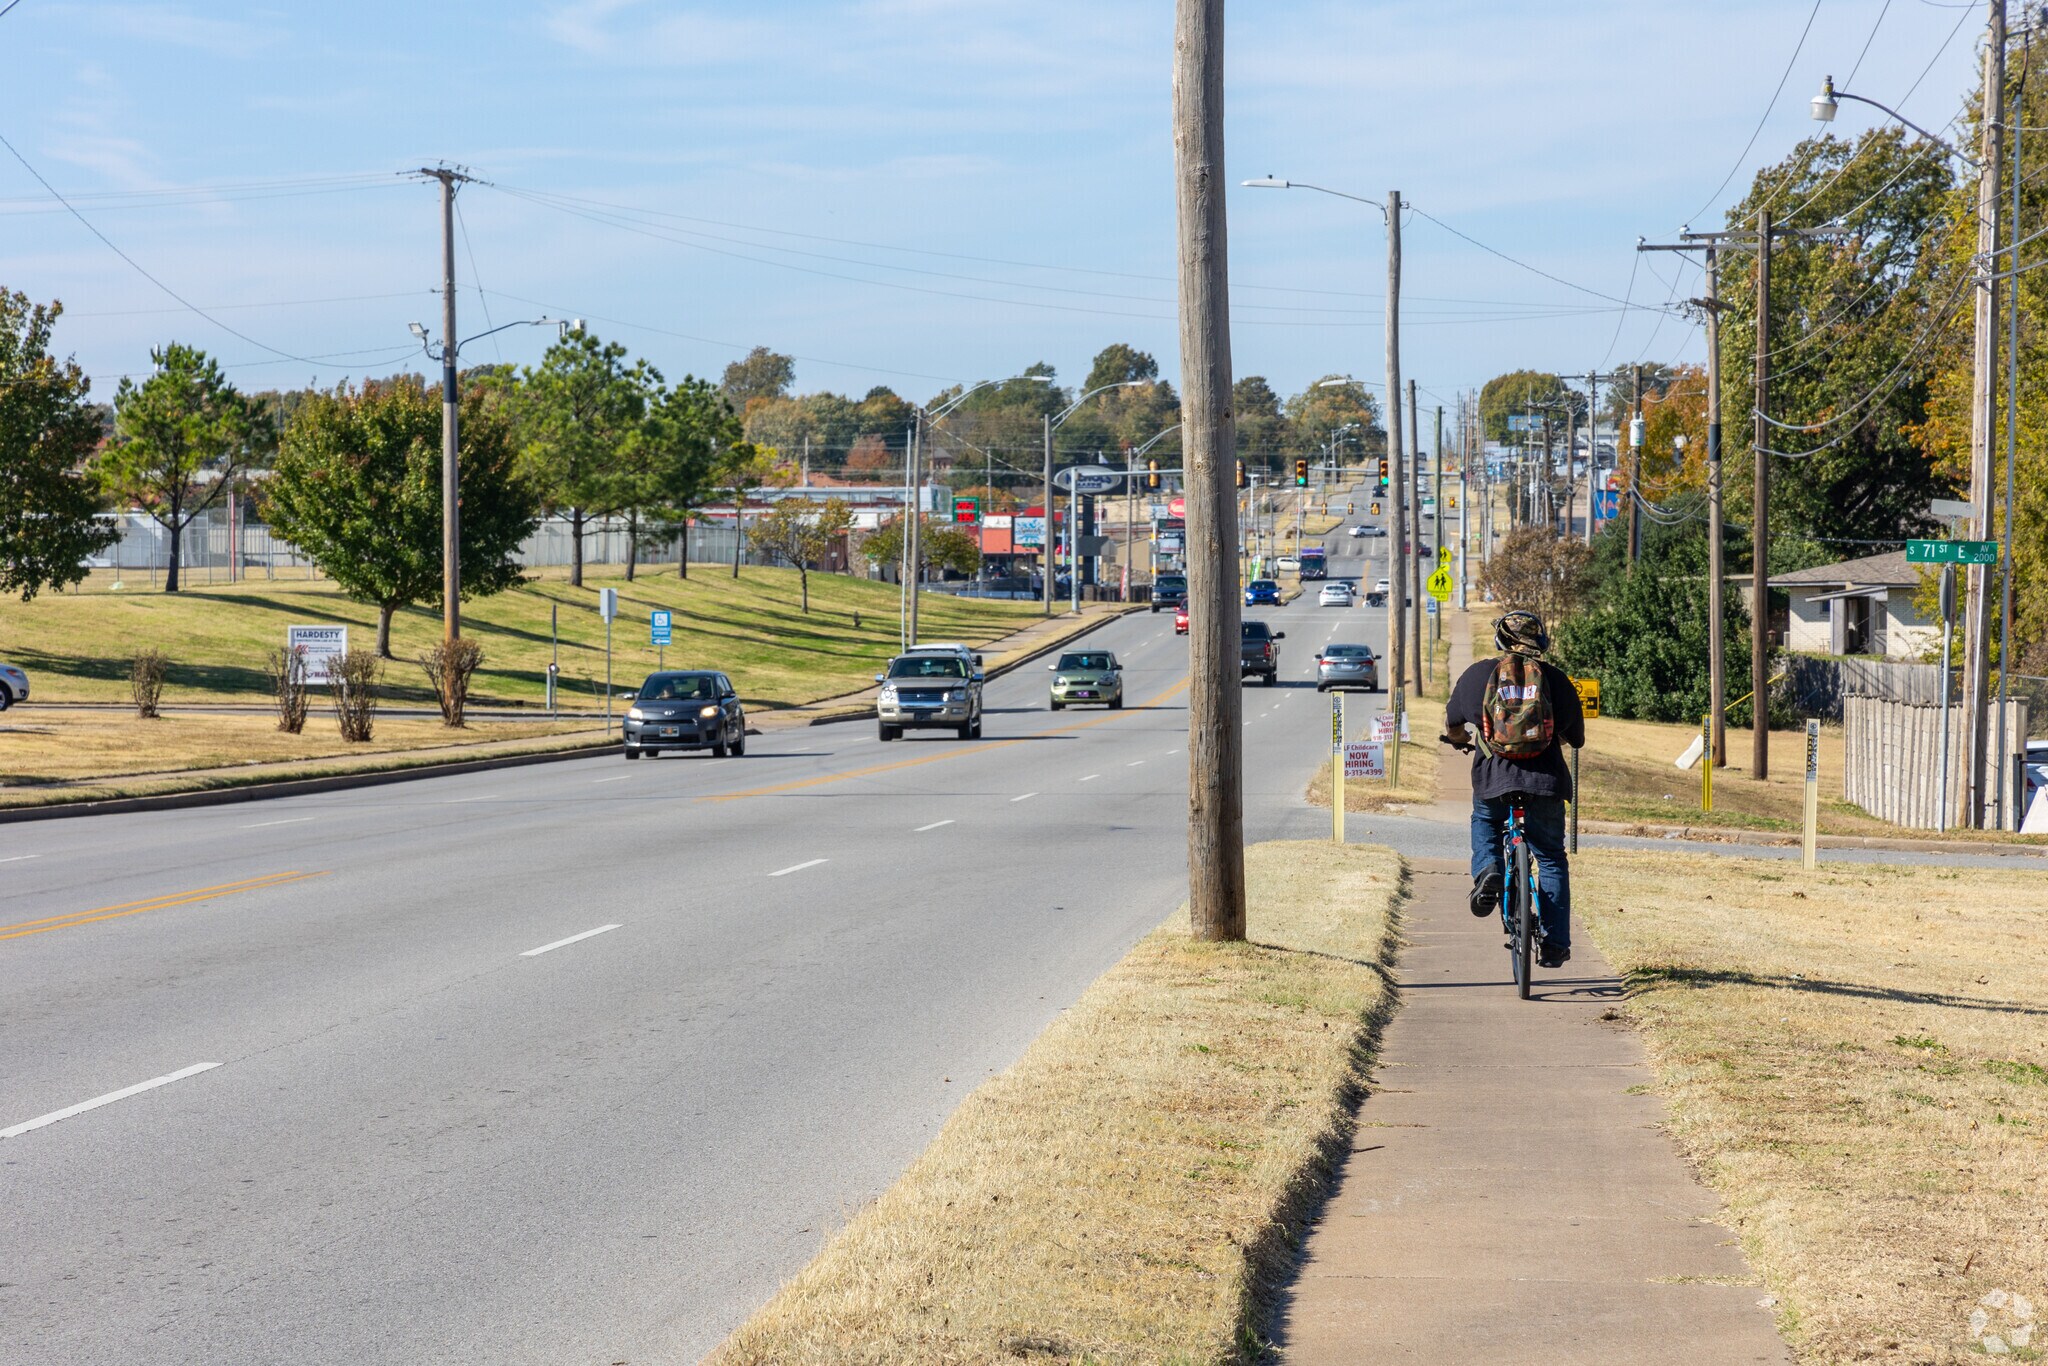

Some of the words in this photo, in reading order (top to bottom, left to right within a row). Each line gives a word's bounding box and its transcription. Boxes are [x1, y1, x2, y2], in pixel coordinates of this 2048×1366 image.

[1909, 546, 1915, 555] S
[1923, 544, 1935, 558] 71
[1939, 545, 1948, 553] ST
[1958, 545, 1966, 559] E
[1980, 545, 1989, 553] AV
[1973, 554, 1995, 562] 2000
[1345, 760, 1374, 768] HIRING
